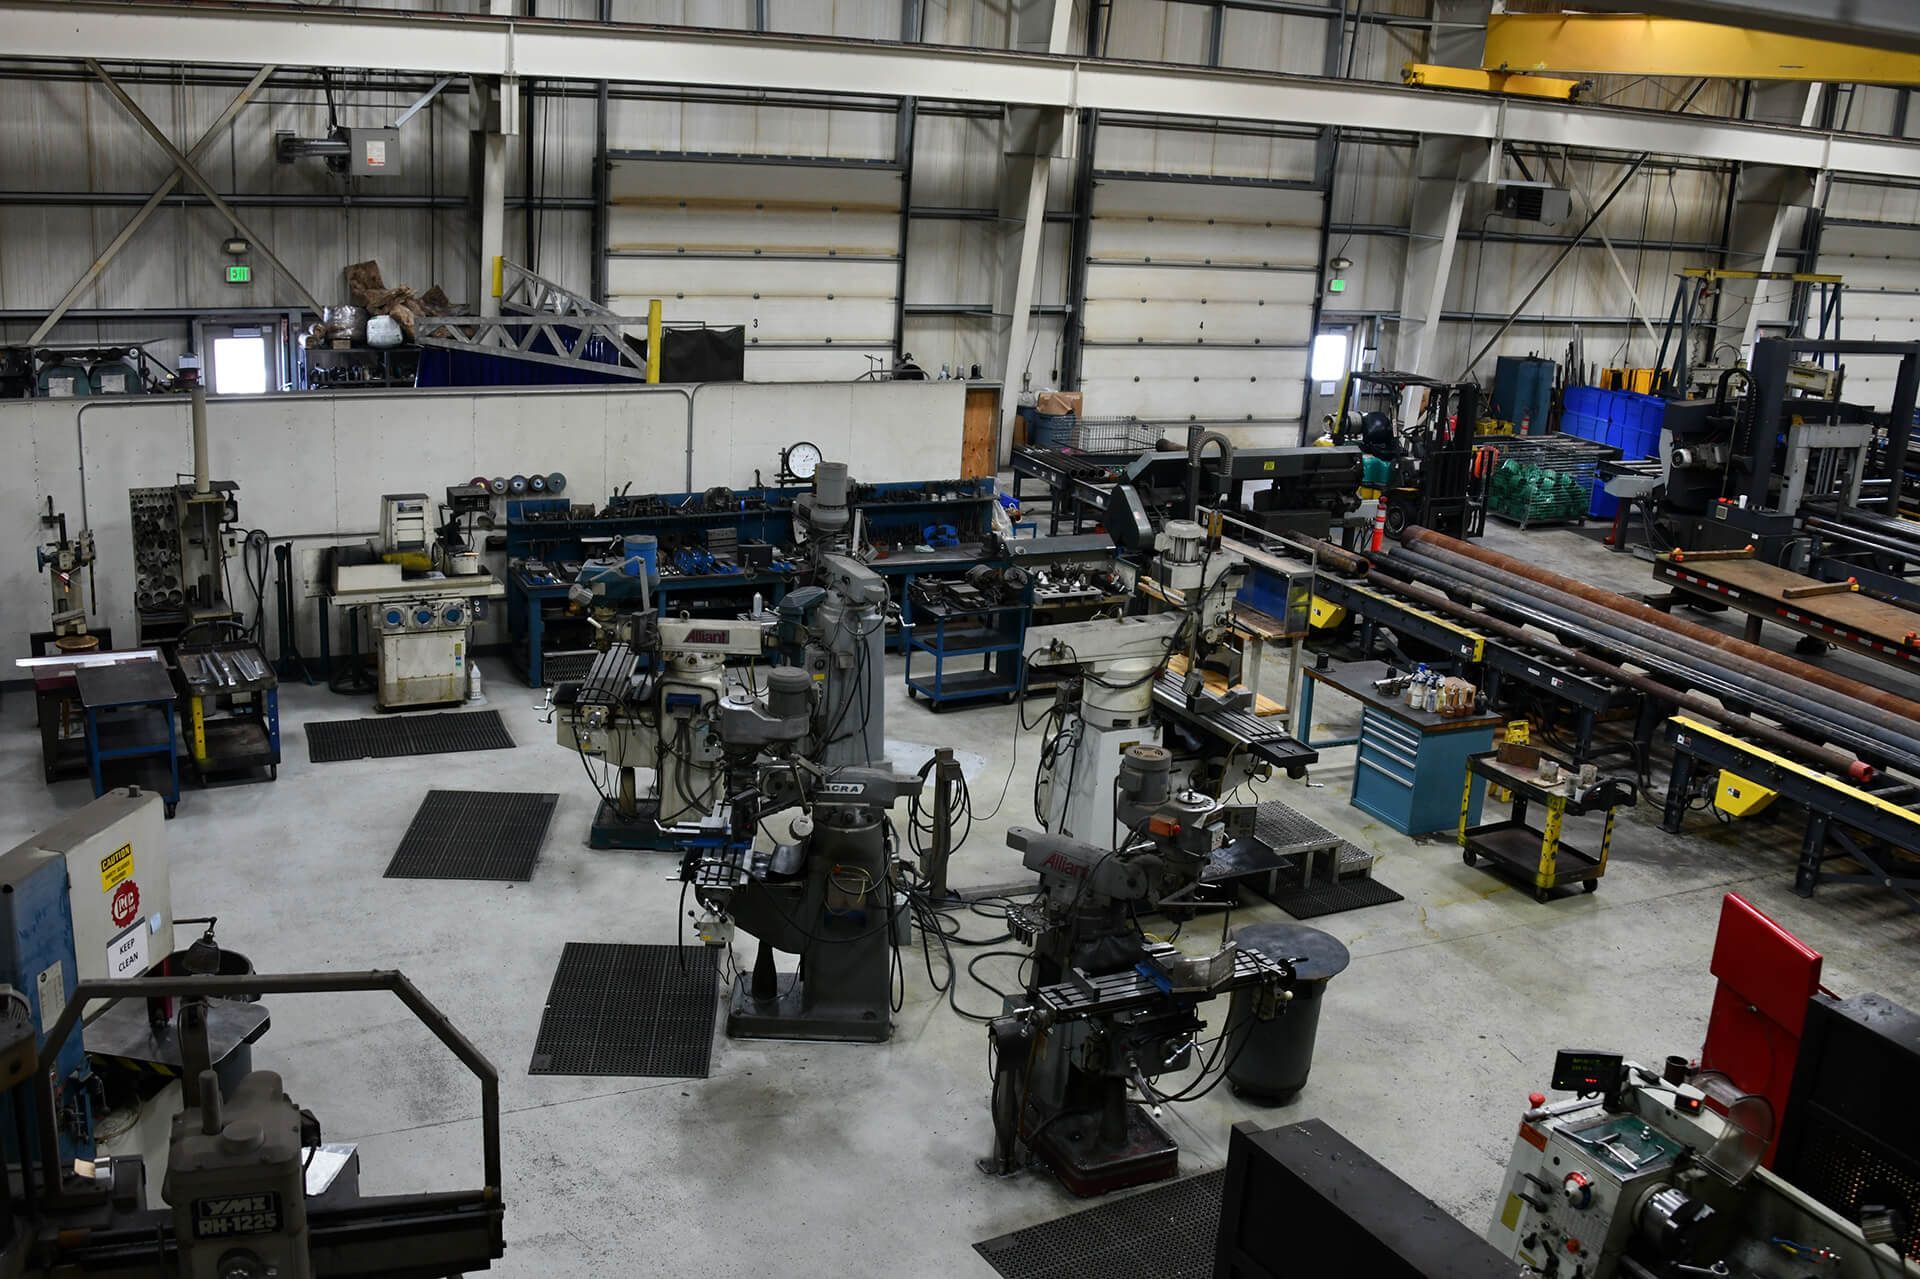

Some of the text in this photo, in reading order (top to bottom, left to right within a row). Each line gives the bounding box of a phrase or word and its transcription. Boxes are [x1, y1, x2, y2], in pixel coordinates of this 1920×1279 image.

[230, 267, 249, 281] EXIT
[753, 318, 758, 329] 3
[684, 630, 728, 643] Alliant
[102, 845, 130, 870] CAUTION
[119, 938, 135, 955] KEEP
[118, 952, 139, 972] CLEAN
[198, 1213, 277, 1235] RH-1225
